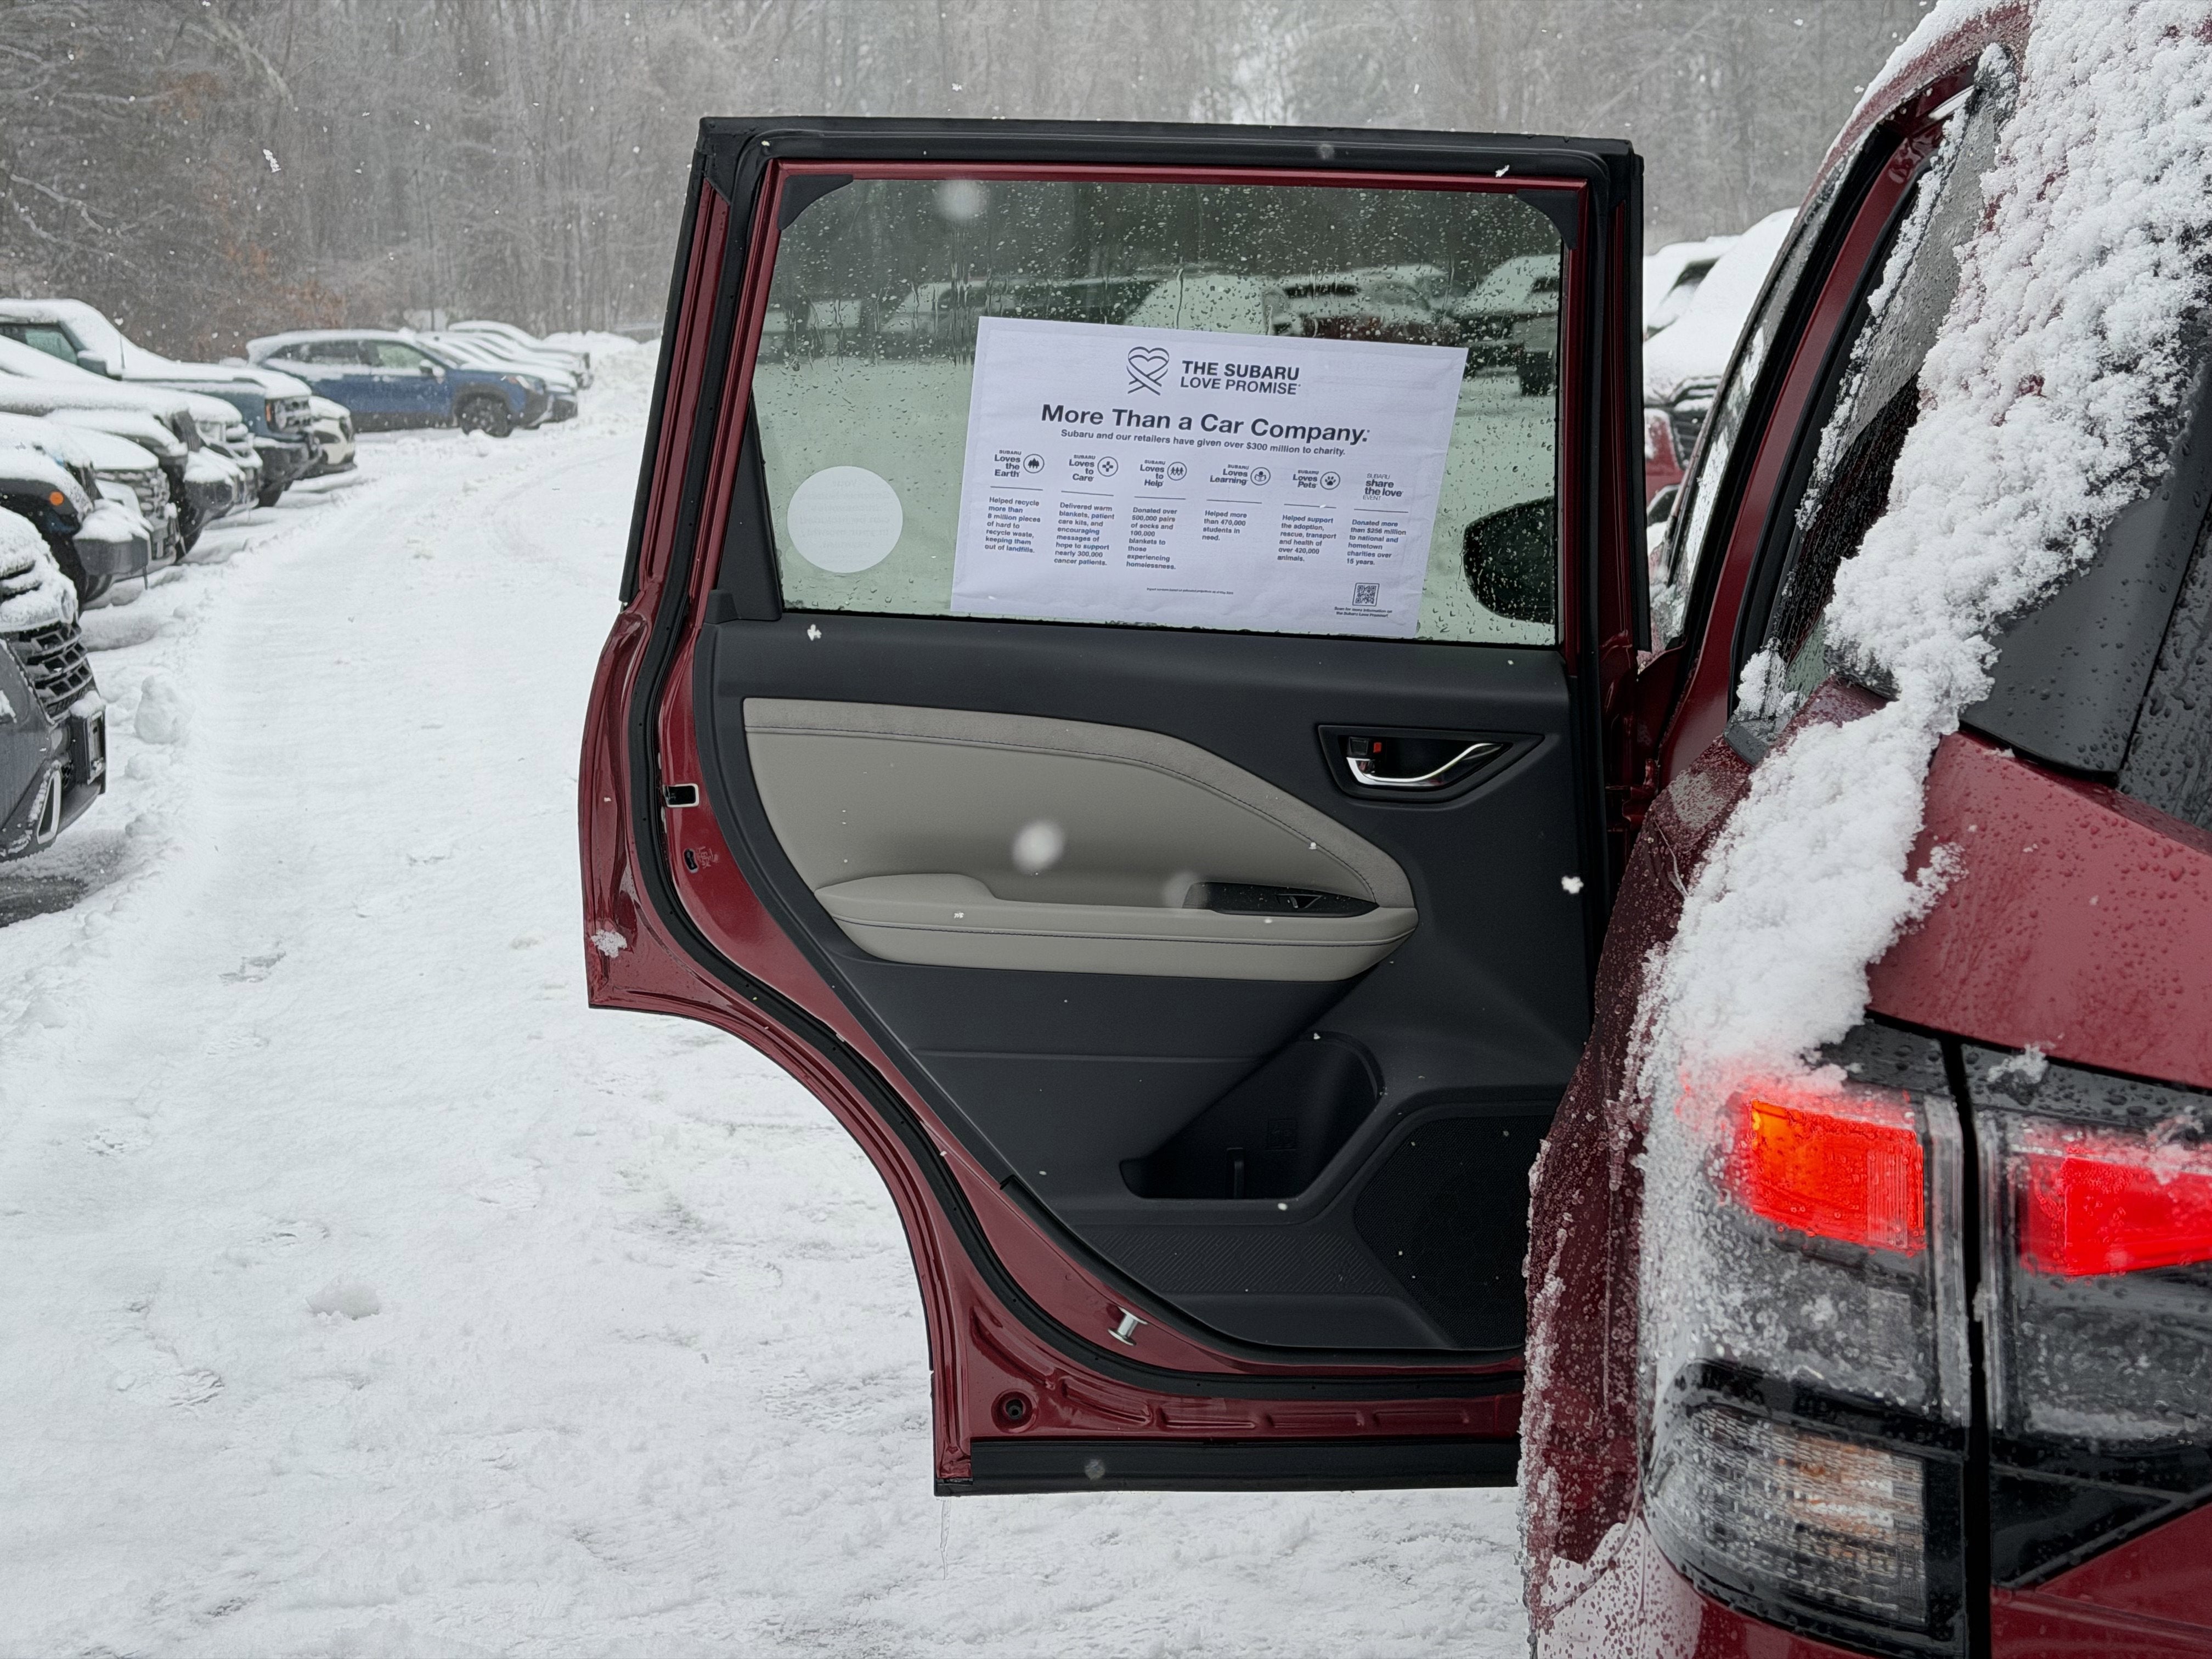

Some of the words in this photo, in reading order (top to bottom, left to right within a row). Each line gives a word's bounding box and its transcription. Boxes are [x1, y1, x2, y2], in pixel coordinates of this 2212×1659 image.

[1182, 360, 1218, 375] THE
[1223, 363, 1300, 381] SUBARU
[1180, 376, 1221, 390] LOVE
[1041, 404, 1104, 425] More
[1111, 408, 1171, 429] Than
[1178, 415, 1192, 430] a
[1200, 413, 1244, 435] Car
[1060, 429, 1094, 439] Subaru
[1096, 431, 1114, 439] and
[1133, 434, 1171, 443] retailers
[1173, 437, 1194, 445] have
[1197, 438, 1221, 448] given
[1223, 440, 1244, 448] over
[1246, 441, 1267, 452] $300
[1269, 444, 1300, 453] million
[1302, 445, 1312, 454] to
[1314, 447, 1346, 456] charity.
[994, 454, 1021, 463] Loves
[1069, 459, 1095, 467] Loves
[1139, 464, 1165, 473] Loves
[1222, 469, 1248, 477] Loves
[1293, 474, 1317, 482] Loves
[1365, 479, 1394, 488] share
[1364, 487, 1381, 496] the
[989, 496, 1013, 505] Helped
[1015, 498, 1040, 506] recycle
[1060, 502, 1092, 510] Delivered
[1059, 510, 1090, 518] blankets,
[1205, 510, 1228, 518] Helped
[1057, 527, 1100, 535] encouraging
[1293, 523, 1324, 532] adoption,
[985, 536, 1012, 544] keeping
[1006, 545, 1035, 554] landfills.
[1294, 547, 1319, 555] 420,000
[1127, 554, 1170, 562] experiencing
[1126, 561, 1176, 570] homelessness.
